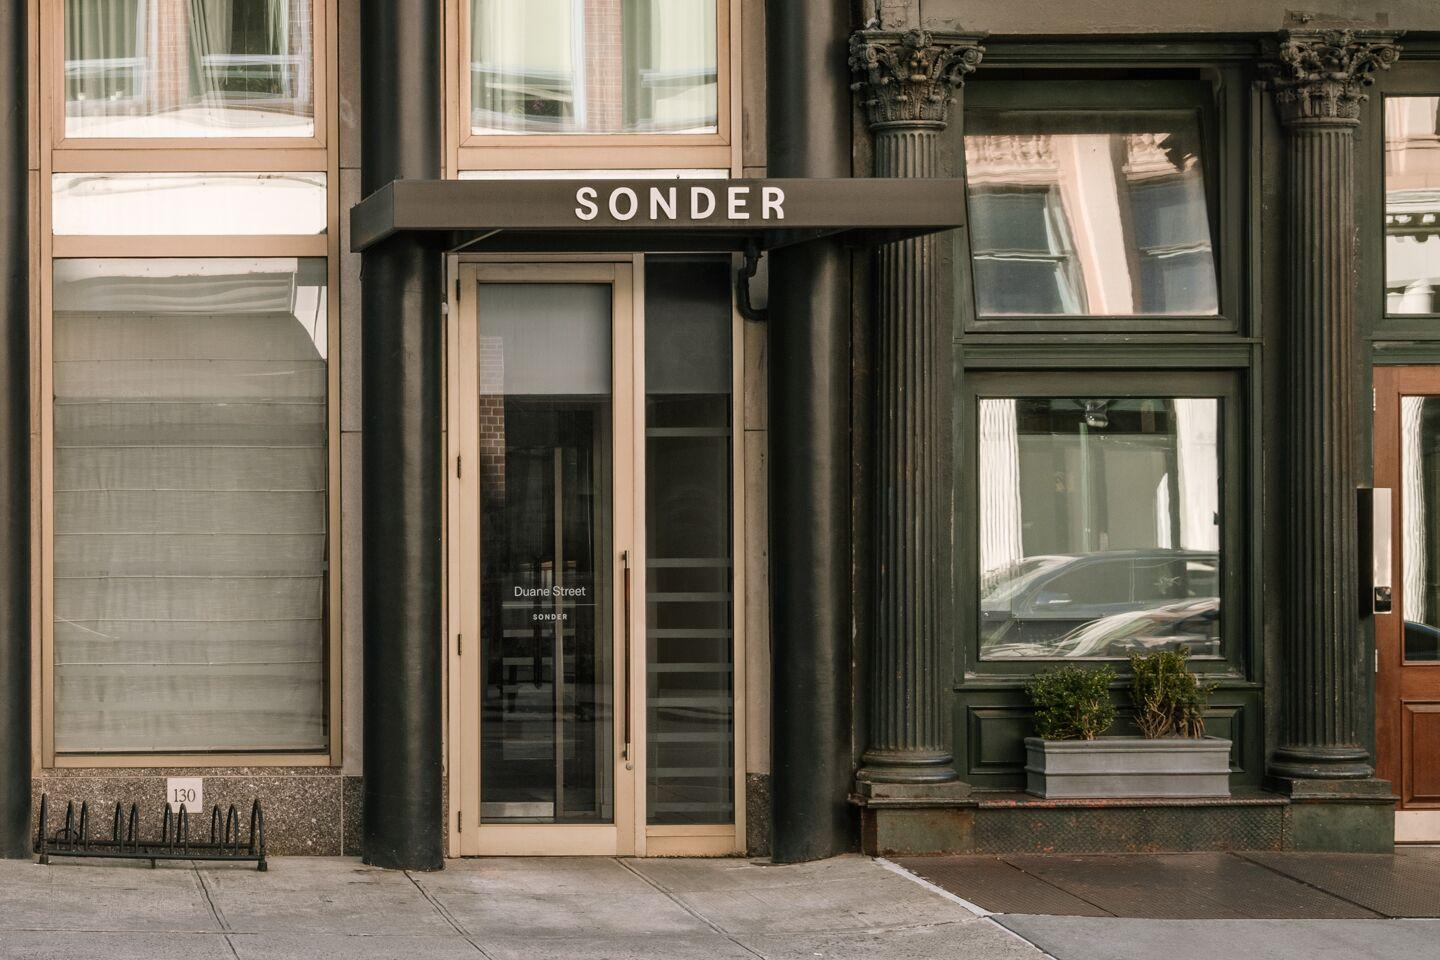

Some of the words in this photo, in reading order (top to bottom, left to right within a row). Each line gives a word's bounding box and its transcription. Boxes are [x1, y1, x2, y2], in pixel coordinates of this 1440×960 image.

[574, 186, 785, 221] SONDER
[514, 586, 550, 597] Duane
[552, 586, 586, 597] Street
[533, 613, 568, 621] SONDER
[174, 788, 196, 803] 130
